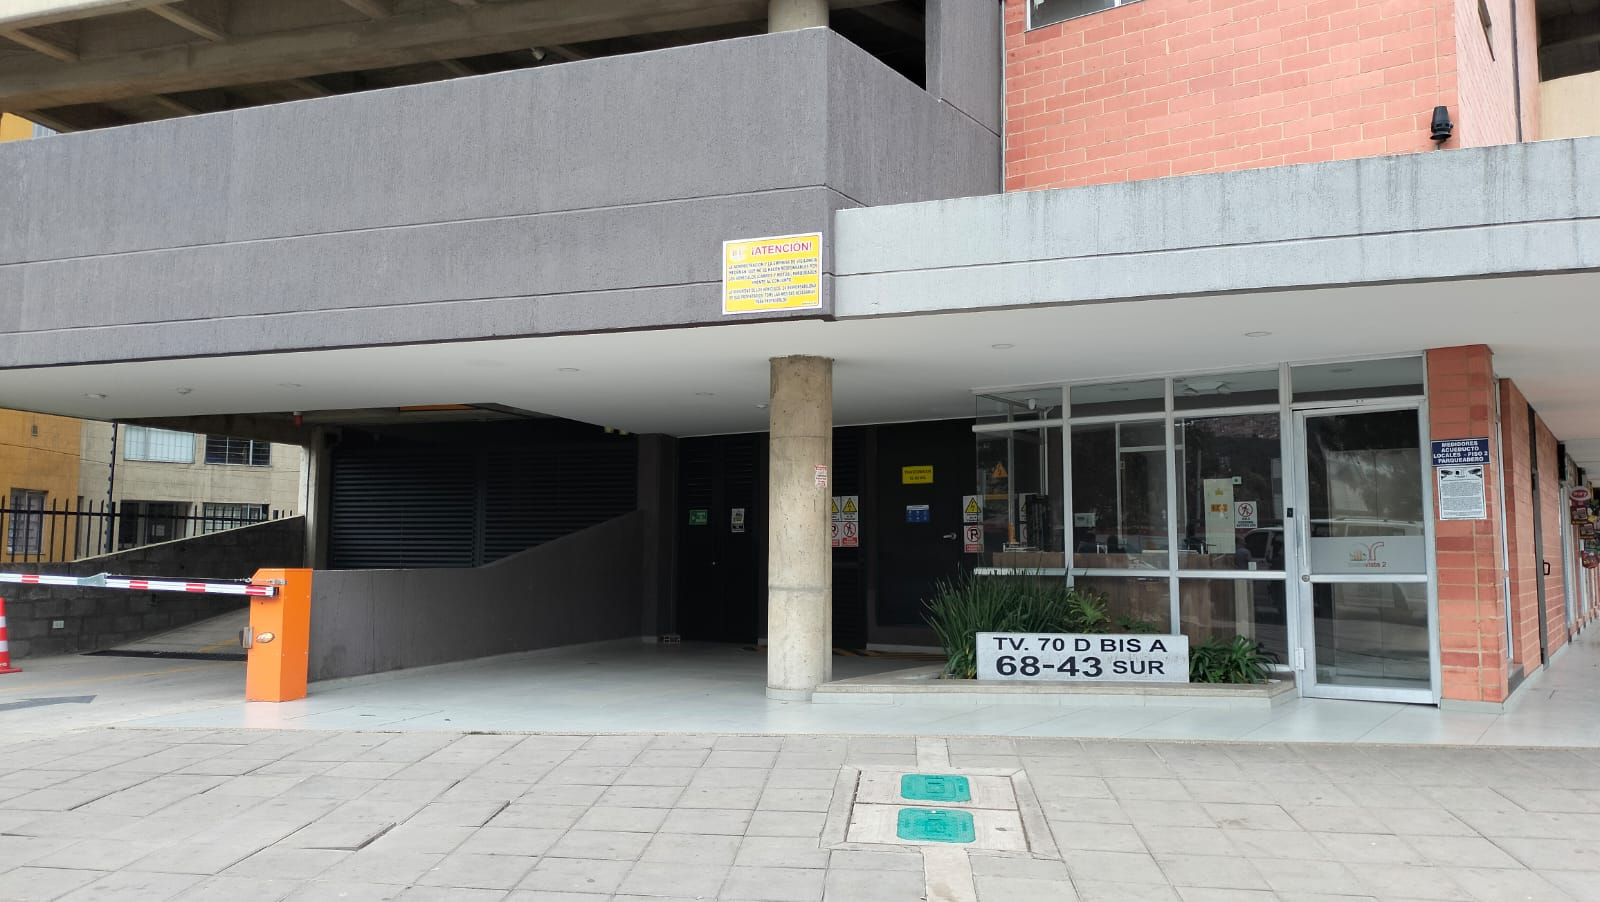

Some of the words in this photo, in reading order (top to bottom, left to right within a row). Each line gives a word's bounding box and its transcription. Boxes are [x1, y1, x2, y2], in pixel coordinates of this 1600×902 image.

[751, 241, 812, 256] ¡ATENCIÓN!
[993, 637, 1029, 651] TV.
[1038, 638, 1065, 651] 70
[1075, 639, 1090, 652] D
[1100, 639, 1142, 652] BIS
[1149, 639, 1168, 652] A
[996, 655, 1103, 677] 68-43
[1113, 660, 1165, 675] SUR
